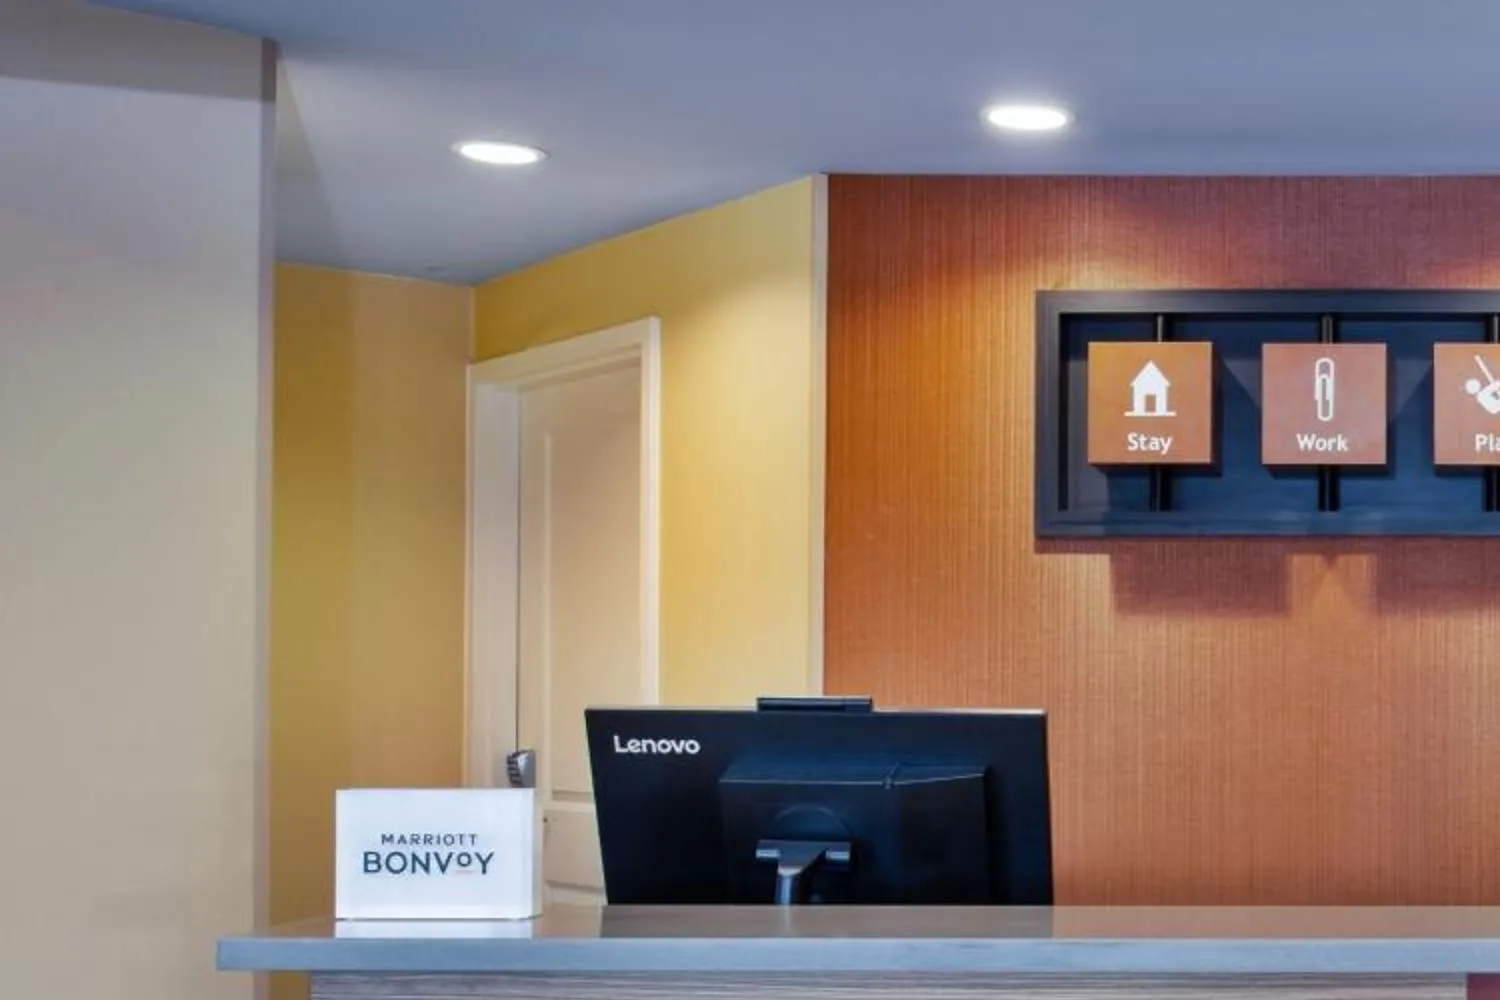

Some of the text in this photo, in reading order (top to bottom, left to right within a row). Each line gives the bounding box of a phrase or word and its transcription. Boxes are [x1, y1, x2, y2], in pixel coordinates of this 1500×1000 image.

[1127, 433, 1173, 453] Stay
[1296, 433, 1348, 453] Work
[613, 735, 701, 756] Lenovo
[381, 833, 478, 846] MARRIOTT
